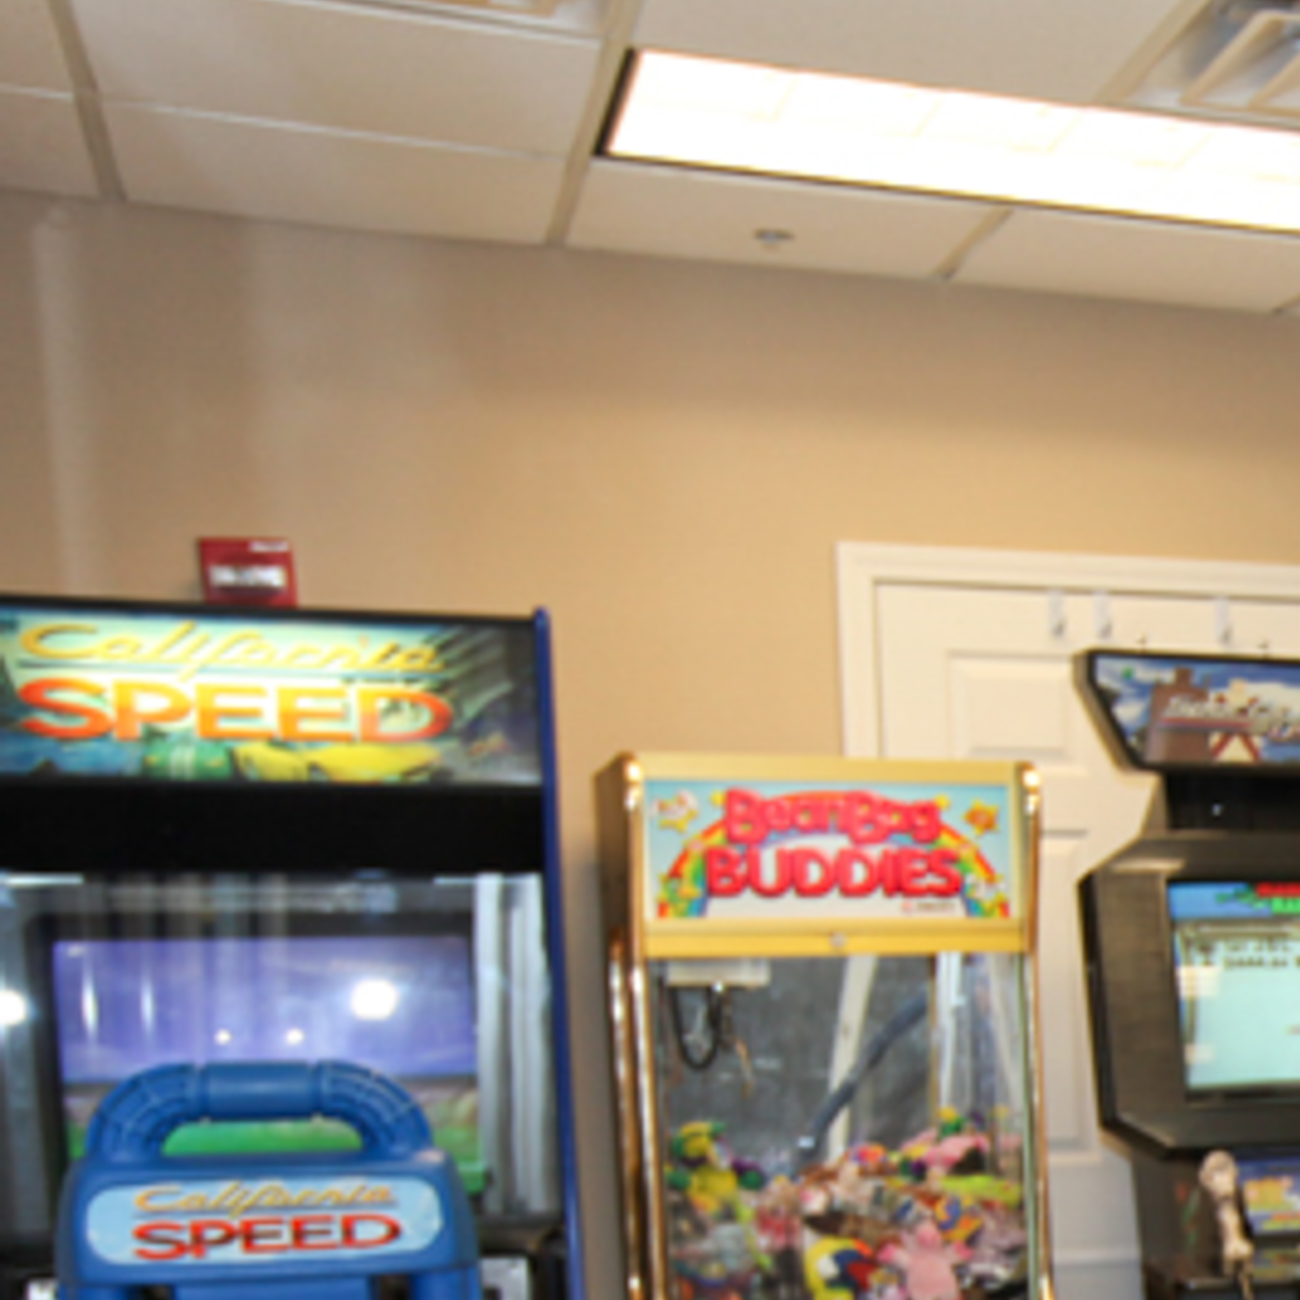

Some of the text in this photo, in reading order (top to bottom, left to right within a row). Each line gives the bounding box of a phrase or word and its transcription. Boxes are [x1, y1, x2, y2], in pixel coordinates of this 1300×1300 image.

[18, 619, 447, 682] California
[16, 676, 455, 741] SPEED
[705, 846, 964, 898] BUDDIES
[133, 1180, 394, 1219] California
[131, 1212, 403, 1261] SPEED
